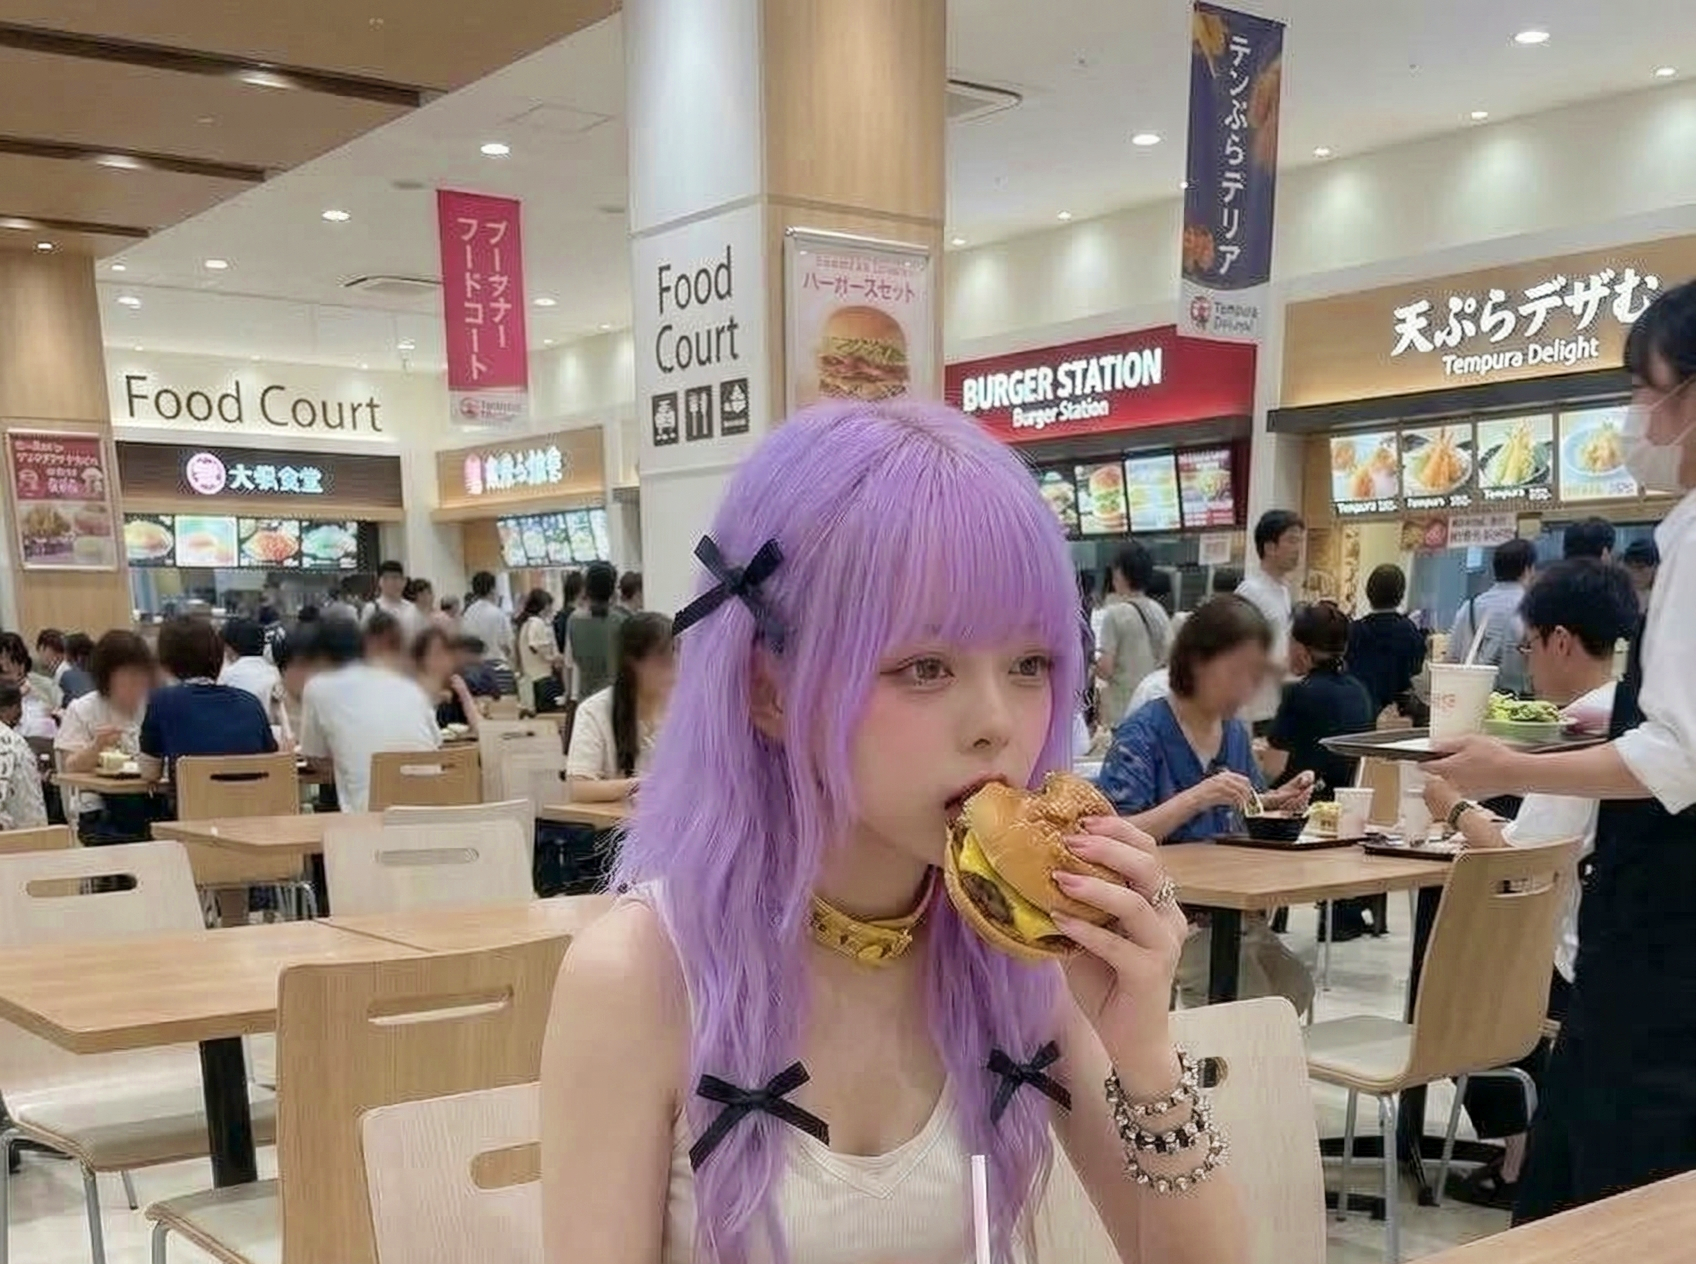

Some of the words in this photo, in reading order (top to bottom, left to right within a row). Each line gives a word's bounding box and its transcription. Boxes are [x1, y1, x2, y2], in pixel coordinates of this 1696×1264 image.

[457, 217, 488, 381] フードコート
[658, 244, 732, 315] Food
[656, 315, 739, 374] Court
[1442, 353, 1524, 376] Tempura
[1527, 334, 1600, 366] Delight
[125, 374, 244, 423] Food
[260, 384, 382, 433] Court
[963, 366, 1054, 412] BURGER
[1056, 347, 1163, 398] STATION
[1012, 406, 1058, 430] Burger
[1059, 397, 1110, 422] Station
